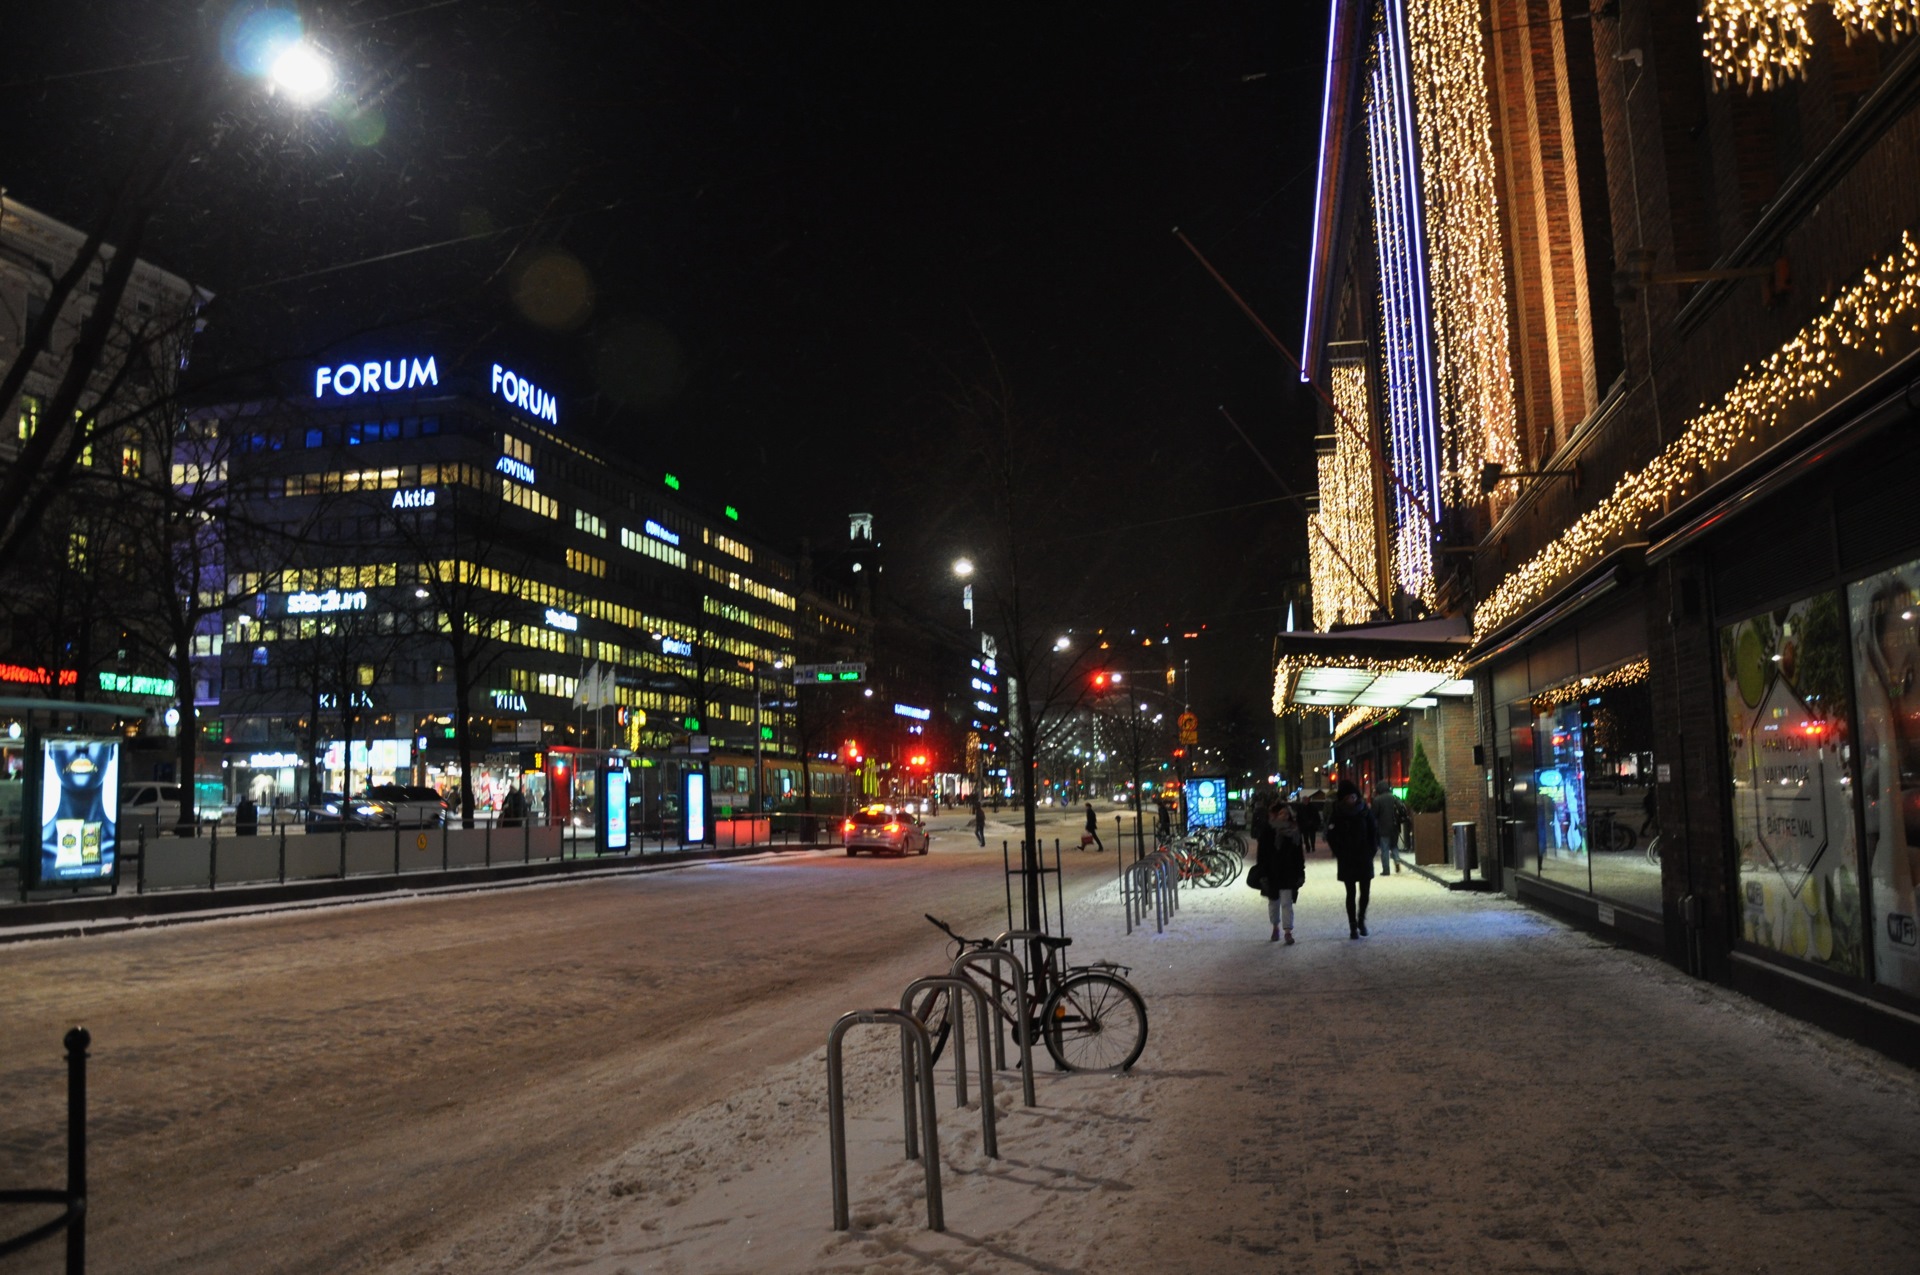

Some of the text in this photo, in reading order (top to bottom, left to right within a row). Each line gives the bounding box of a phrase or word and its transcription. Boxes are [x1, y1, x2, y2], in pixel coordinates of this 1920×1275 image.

[315, 355, 438, 398] FORUM
[490, 363, 556, 425] FORUM
[495, 456, 534, 485] ADVIUM
[391, 488, 437, 509] Aktia
[288, 589, 366, 613] stadium
[318, 690, 374, 709] KILA
[1798, 817, 1815, 839] VAL
